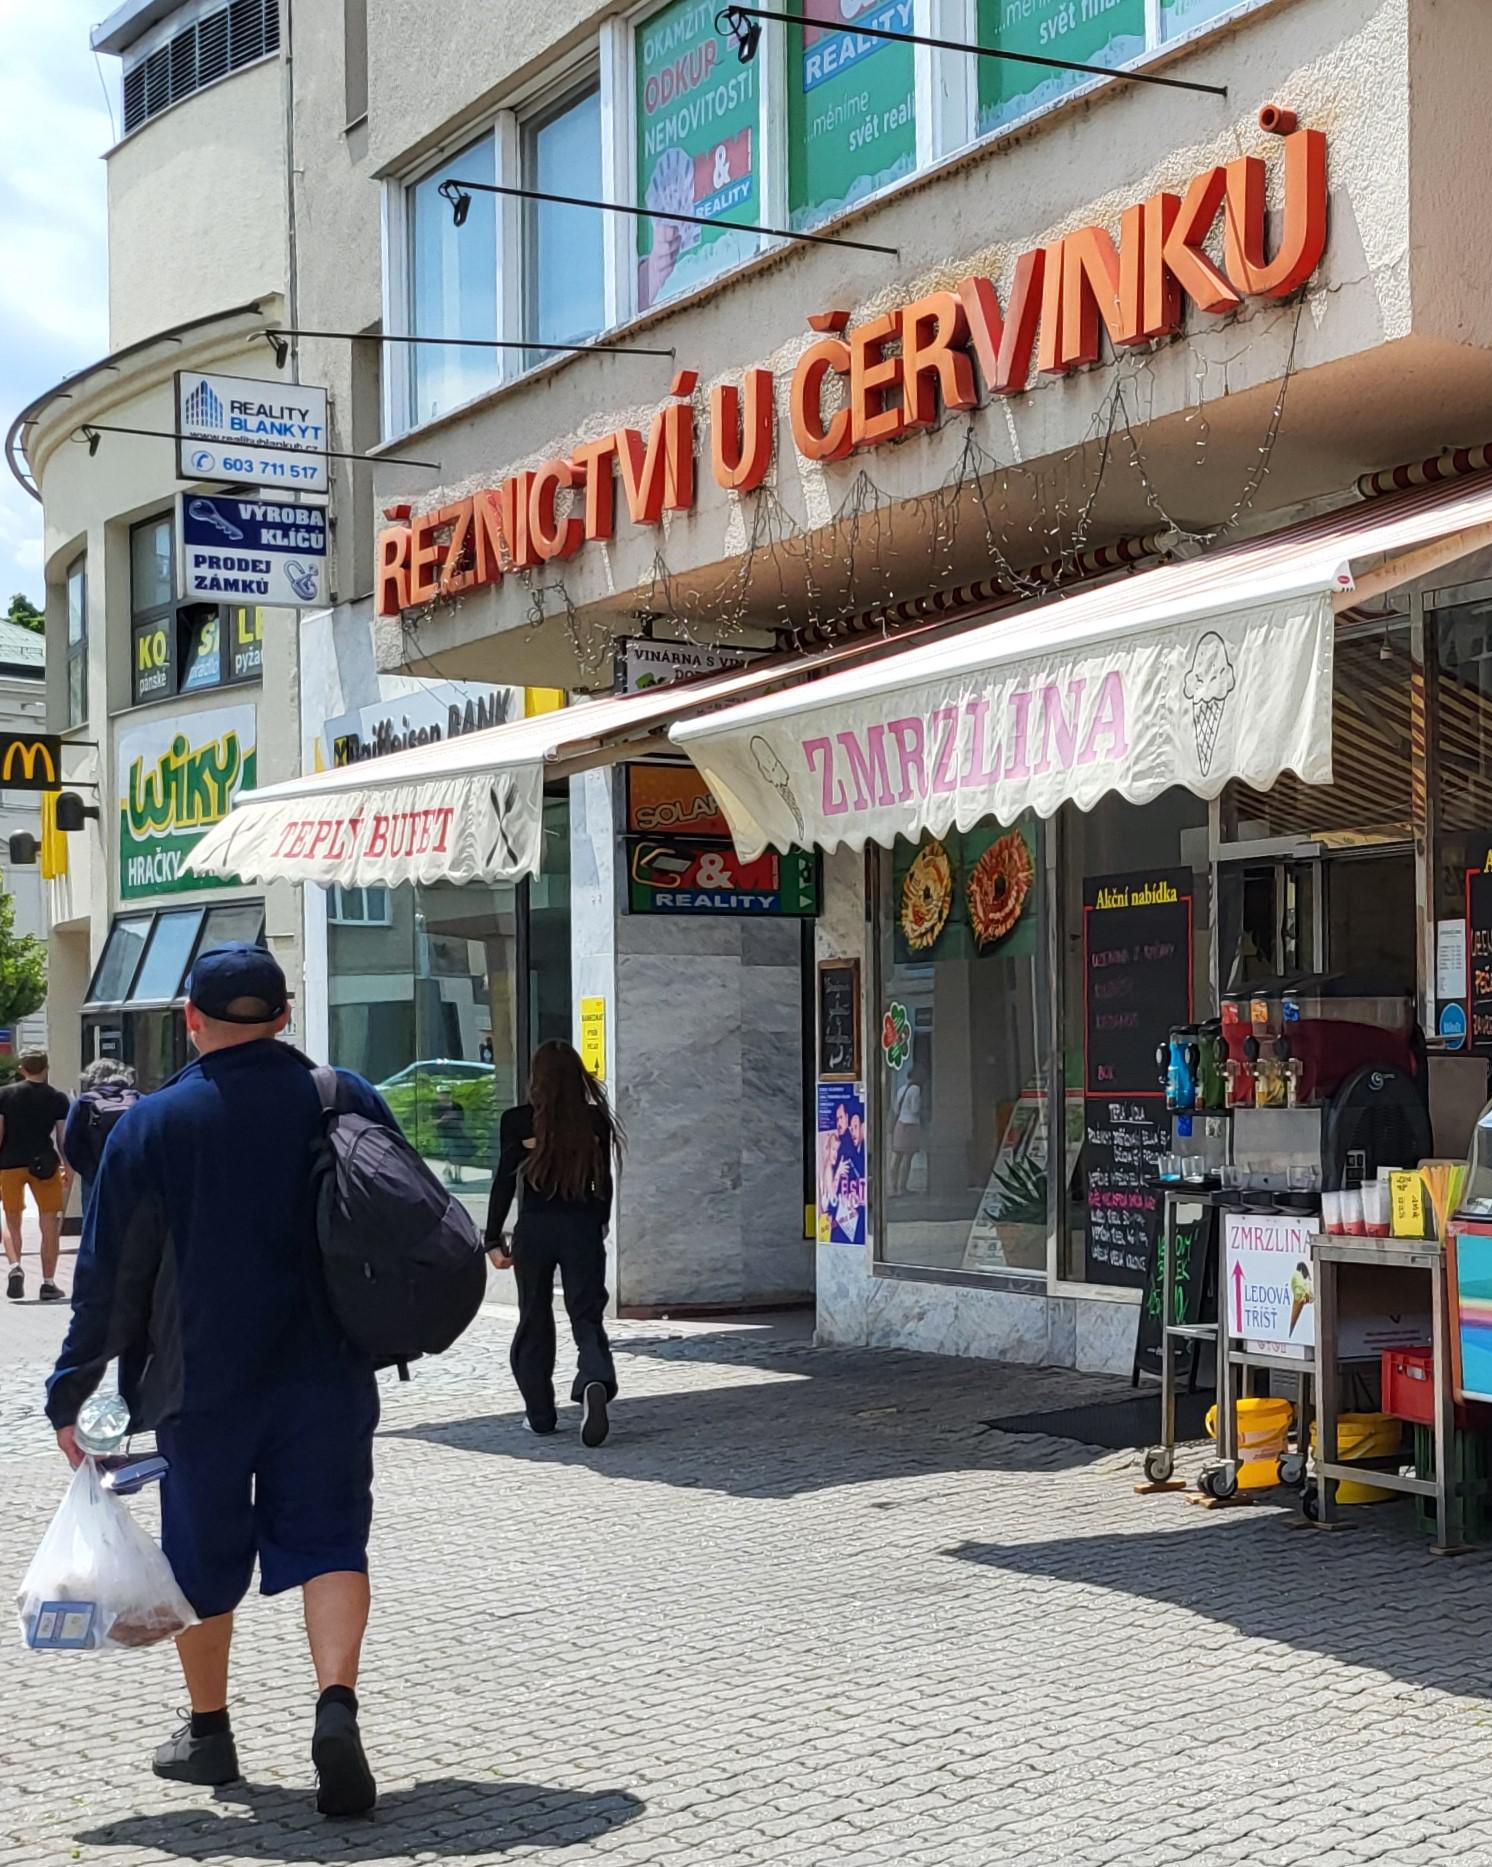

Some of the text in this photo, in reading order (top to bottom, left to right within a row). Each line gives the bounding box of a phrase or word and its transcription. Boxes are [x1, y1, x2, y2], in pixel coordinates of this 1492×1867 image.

[1039, 5, 1077, 45] svět
[805, 4, 912, 84] REALITY
[644, 37, 718, 116] ODKUP
[849, 114, 880, 152] svět
[377, 103, 1330, 617] ŘEZNICTVÍ U ČERVINKŮ
[230, 400, 310, 422] REALITY
[230, 416, 322, 441] BLANKYT
[222, 457, 318, 480] 603 711 517
[238, 501, 324, 527] VÝROBA
[260, 527, 324, 550] KLÍČŮ
[193, 554, 272, 574] PRODEJ
[193, 575, 269, 595] ZÁMKŮ
[634, 649, 702, 666] VINÁRNA
[706, 656, 715, 667] S
[448, 687, 516, 739] BANK
[802, 669, 1131, 817] ZMRZLINA
[270, 803, 455, 862] TEPLÝ BUFET
[128, 846, 182, 887] HRAČKY
[655, 893, 775, 909] REALITY
[1095, 880, 1178, 910] Akční nabídka
[1231, 1225, 1313, 1254] ZMRZLINA
[1245, 1283, 1291, 1306] LEDOVÁ
[1244, 1305, 1278, 1329] TŘÍŠŤ
